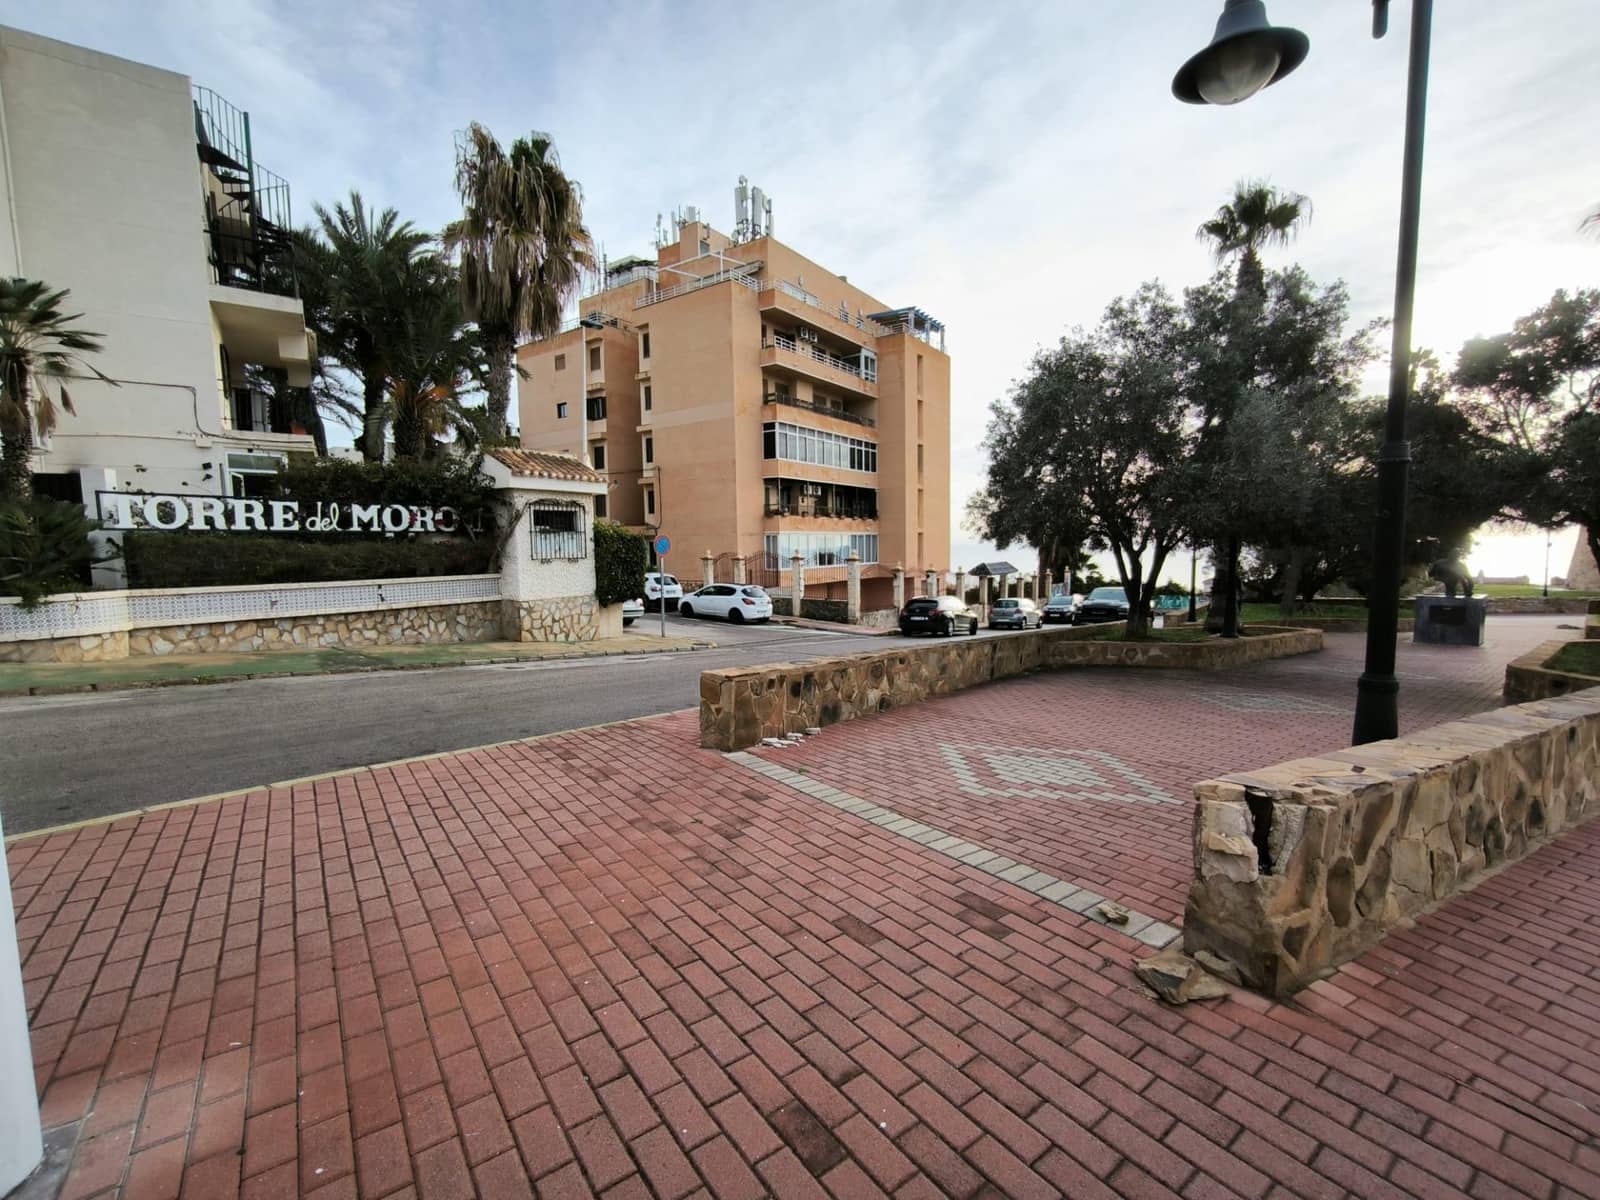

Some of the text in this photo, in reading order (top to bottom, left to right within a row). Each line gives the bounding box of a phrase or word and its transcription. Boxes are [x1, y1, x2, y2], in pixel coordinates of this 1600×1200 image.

[111, 494, 300, 531] TORRE
[305, 501, 342, 532] del
[351, 503, 460, 532] MORO
